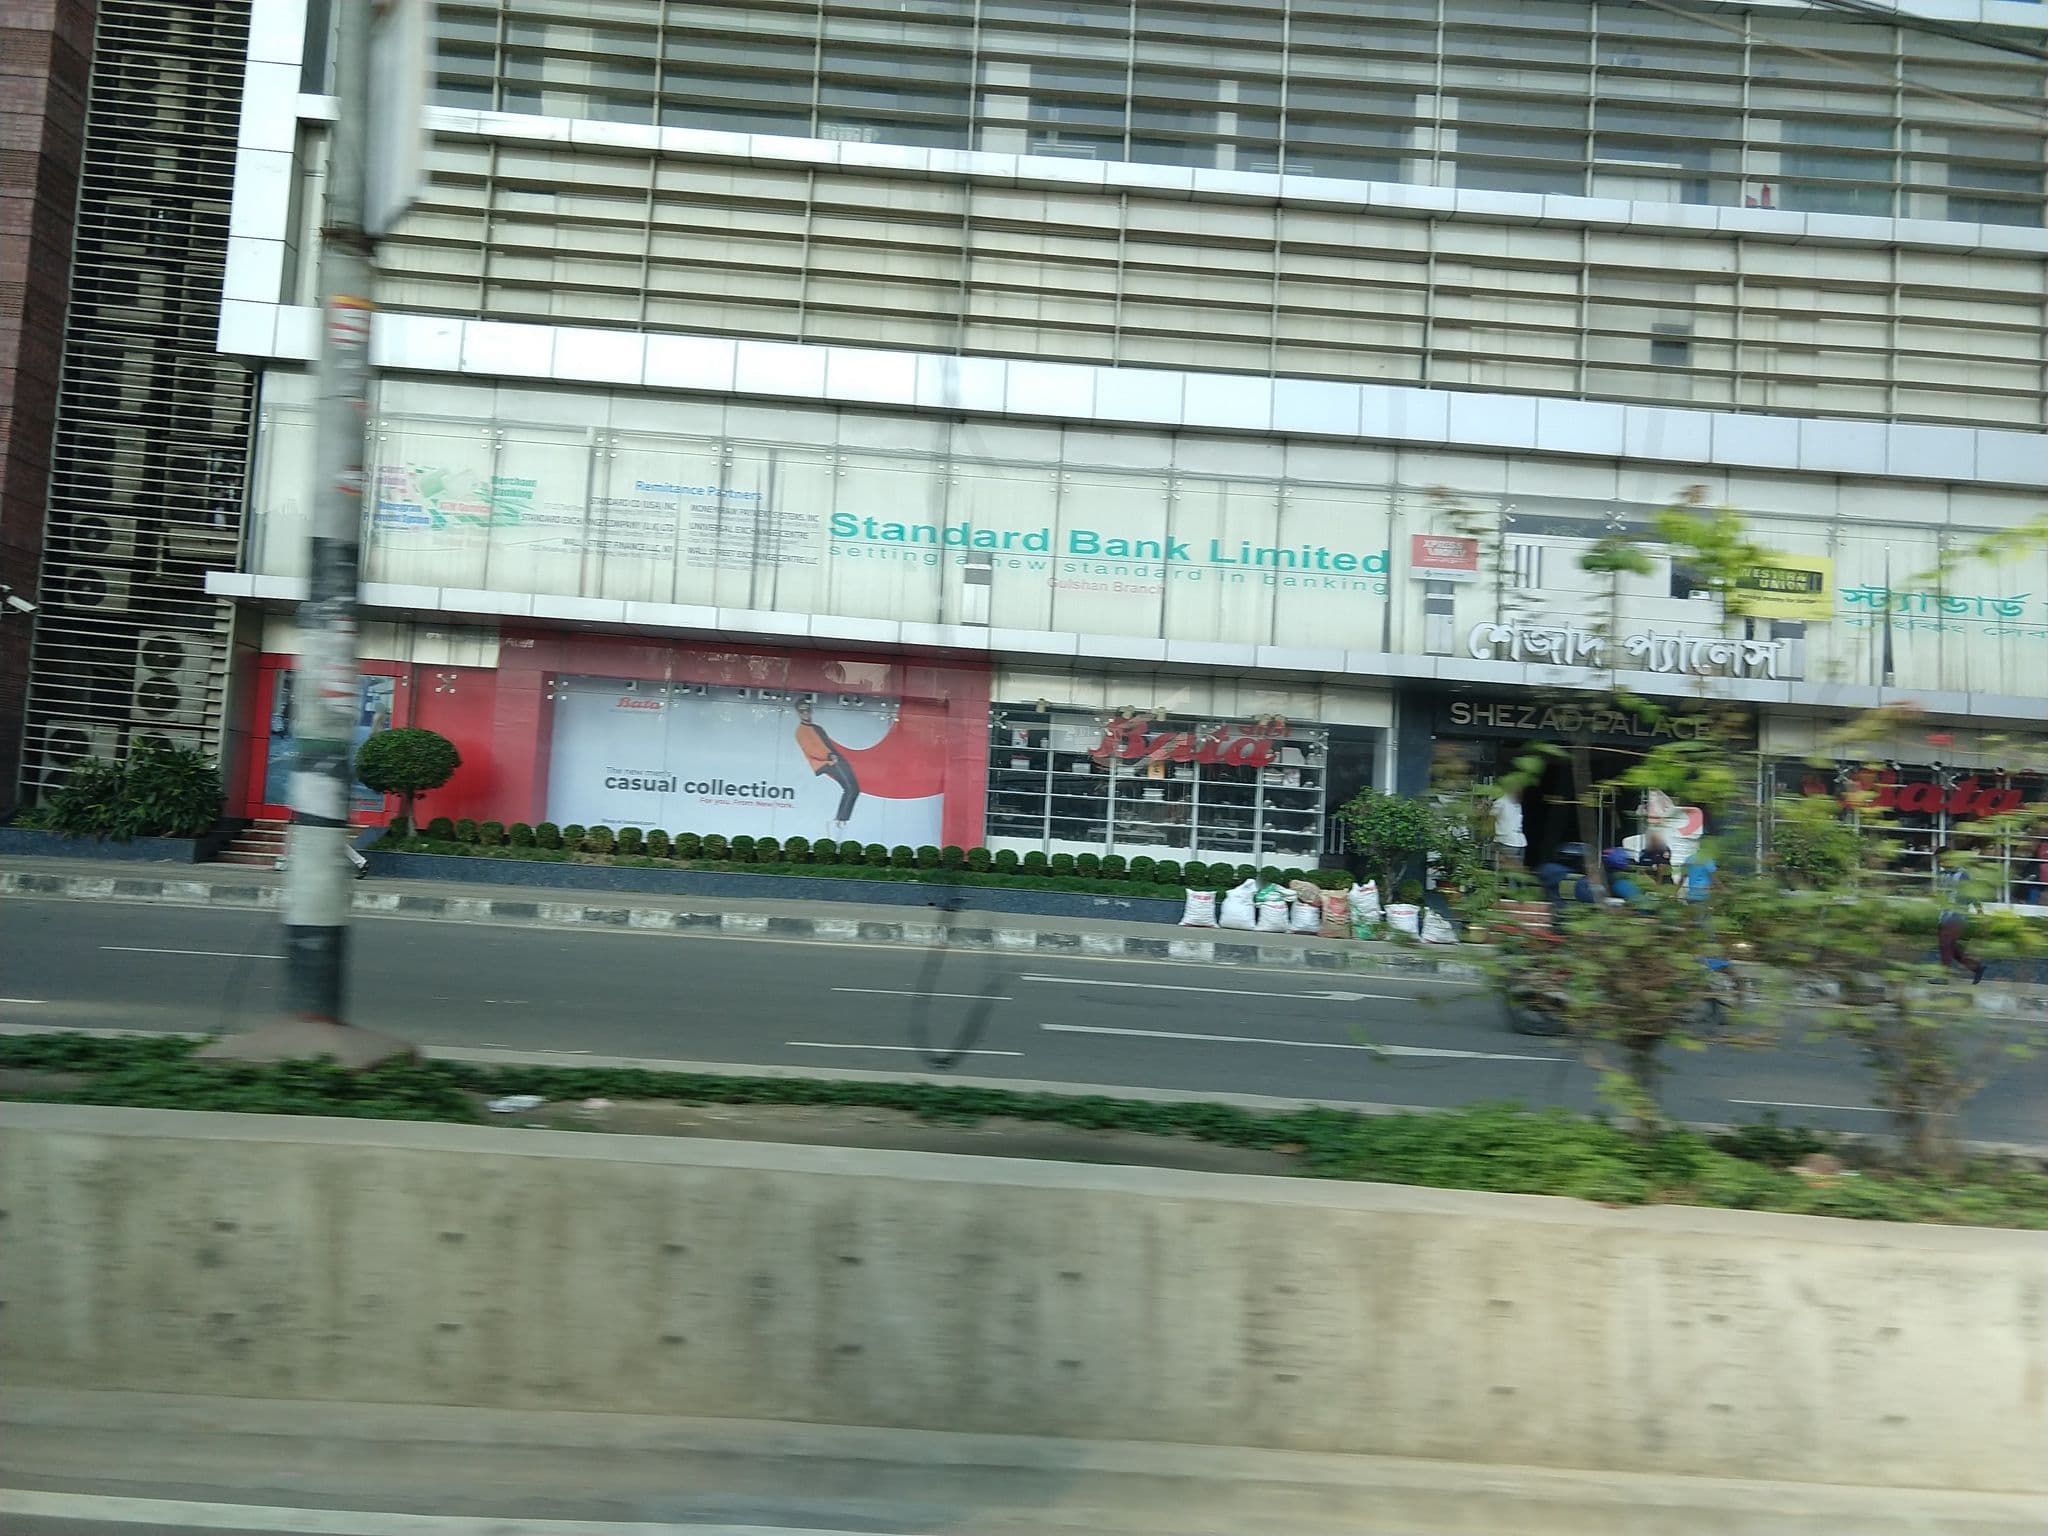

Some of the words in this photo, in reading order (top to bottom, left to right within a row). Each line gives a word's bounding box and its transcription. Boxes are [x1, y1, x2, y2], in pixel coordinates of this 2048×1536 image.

[635, 480, 705, 496] Remittance
[707, 485, 762, 501] Partners
[829, 512, 1049, 551] Standard
[1069, 529, 1191, 562] Bank
[1209, 538, 1390, 574] Limited
[829, 545, 938, 567] setting
[1063, 560, 1202, 583] standard
[1220, 569, 1244, 583] in
[1263, 574, 1388, 596] banking
[1047, 577, 1109, 592] Gulshan
[1112, 581, 1164, 595] Branch
[1759, 578, 1807, 591] UNION
[1467, 619, 1608, 668] শেজাদ
[1622, 628, 1792, 680] প্যালেস
[1449, 702, 1583, 733] SHEZAD
[1591, 711, 1714, 741] PALACE
[1088, 715, 1280, 768] Bata
[604, 776, 678, 793] casual
[684, 779, 796, 800] collection
